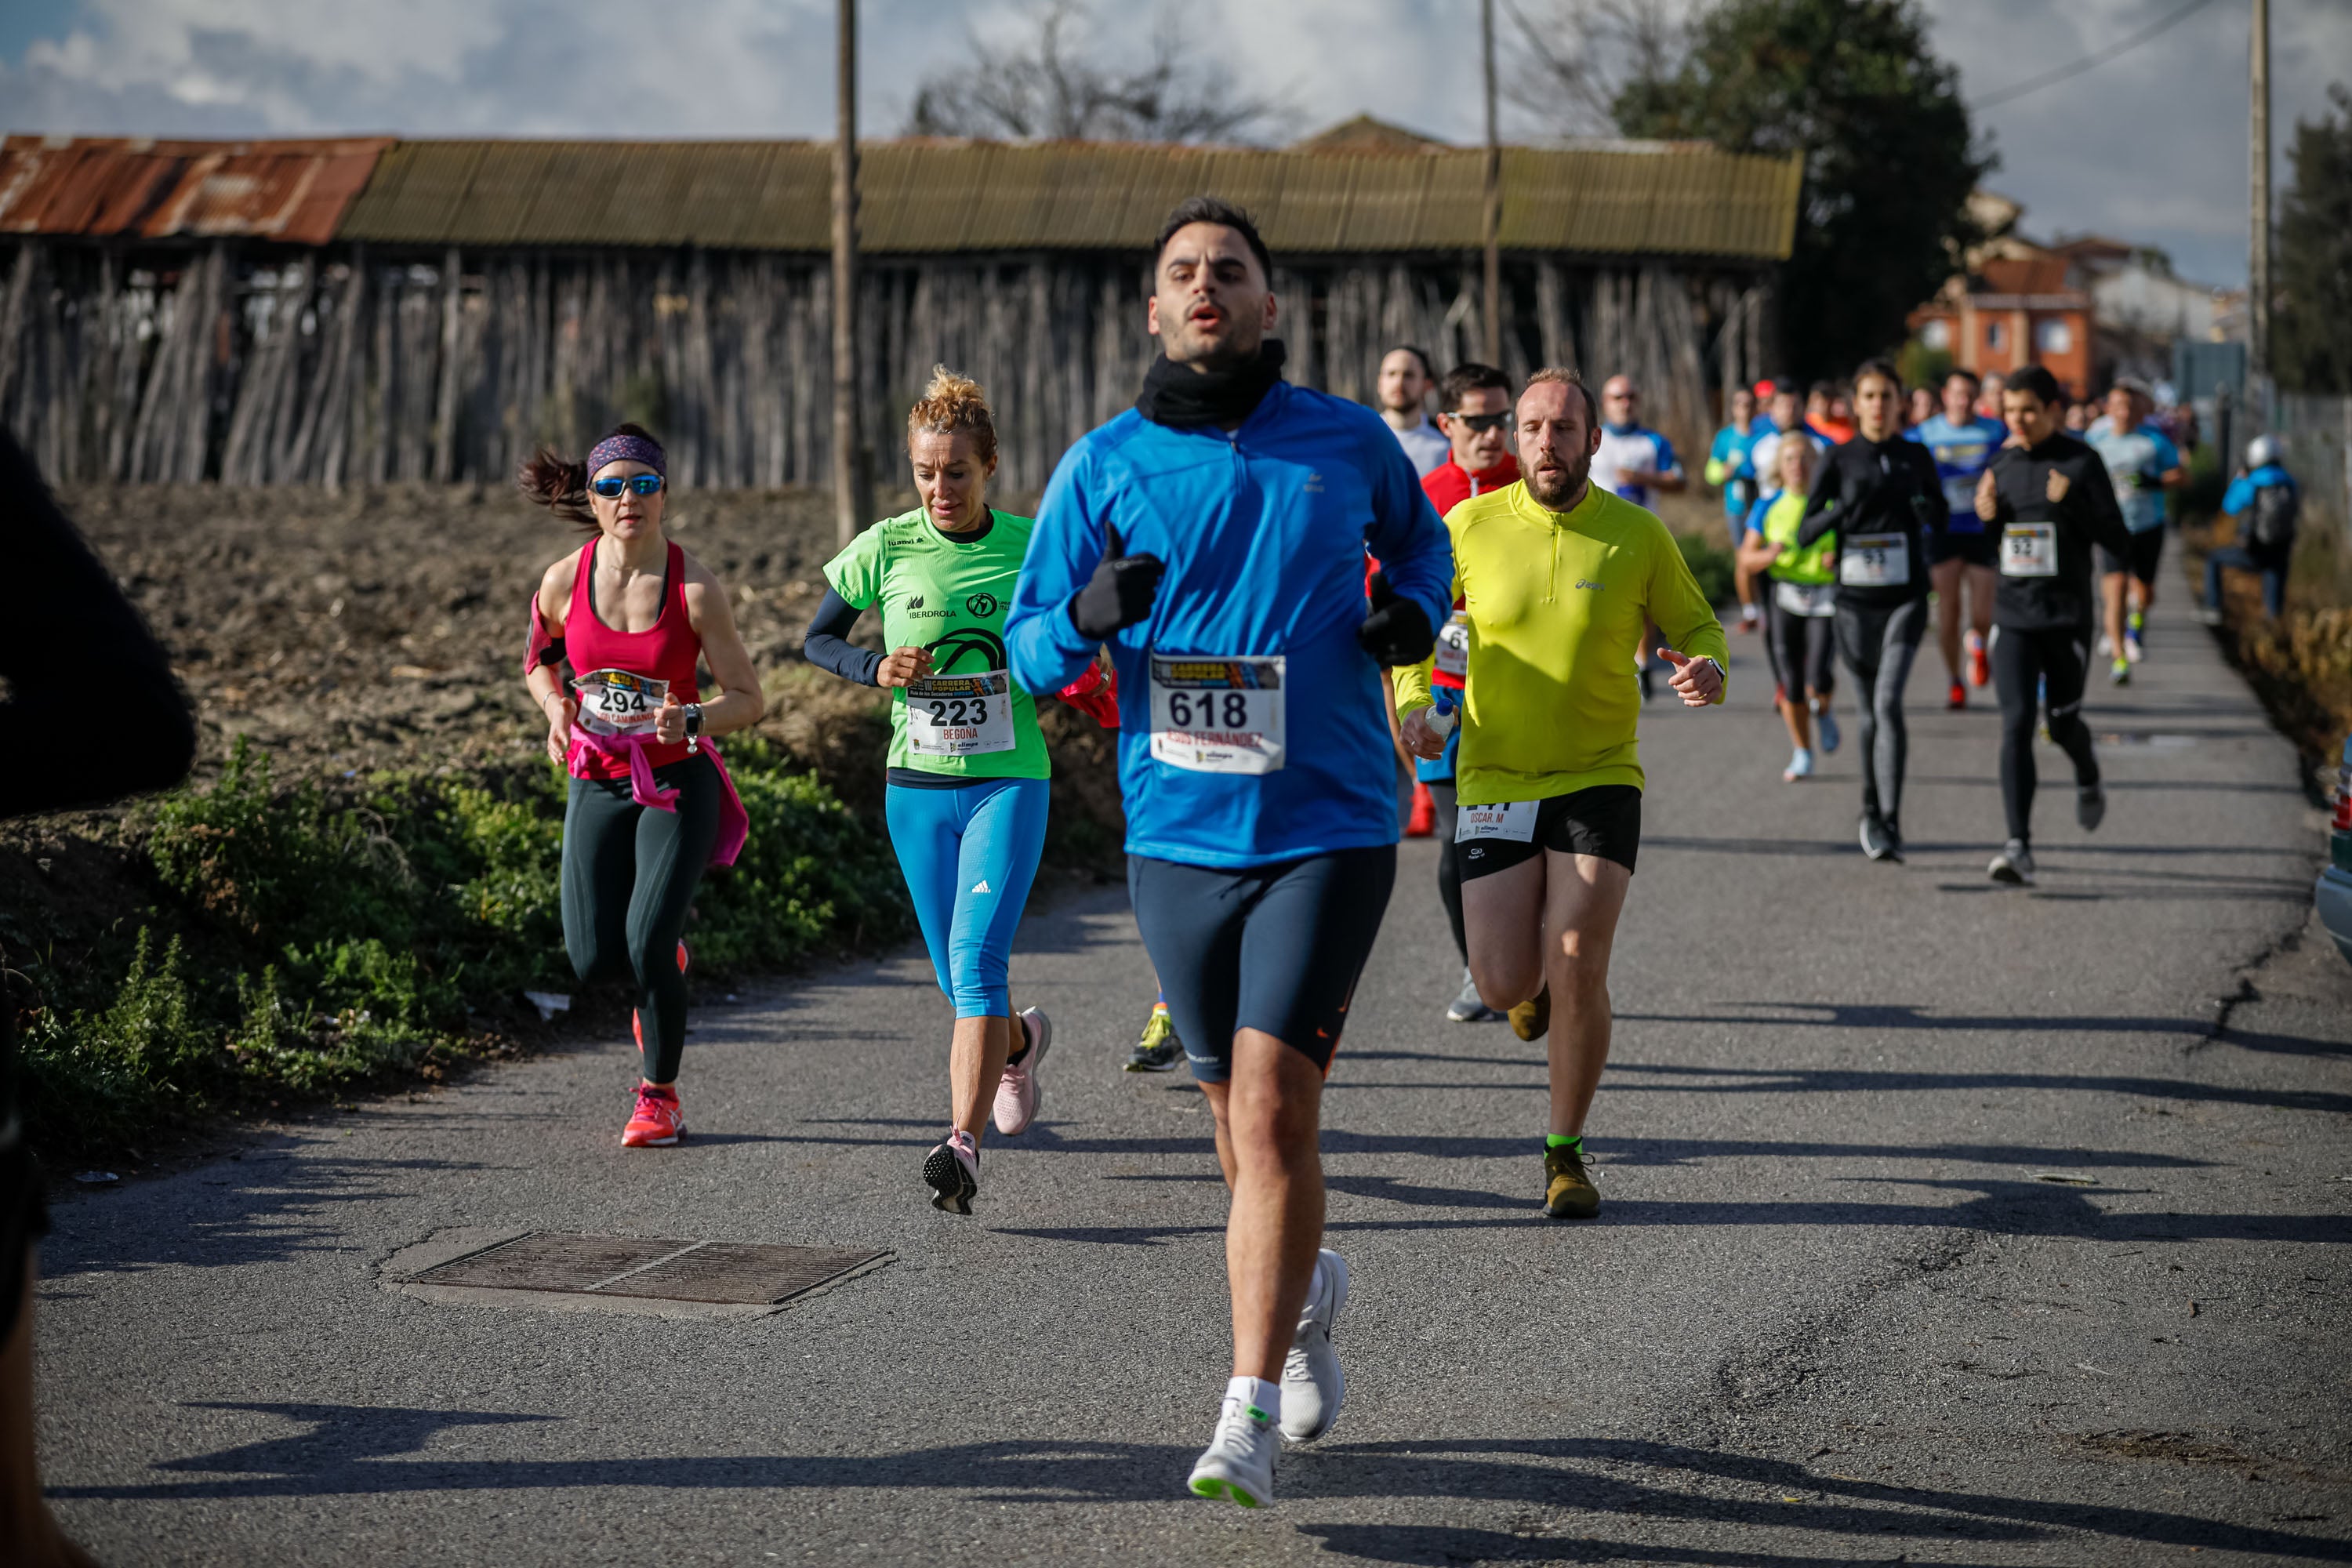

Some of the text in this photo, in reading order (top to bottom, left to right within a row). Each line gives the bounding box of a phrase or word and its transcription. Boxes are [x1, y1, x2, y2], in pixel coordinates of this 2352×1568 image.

[909, 610, 956, 619] IBERDROLA
[600, 688, 648, 713] 294
[1169, 691, 1247, 728] 618
[929, 699, 988, 727] 223
[943, 727, 978, 739] BEGOÑA
[1496, 813, 1504, 823] M
